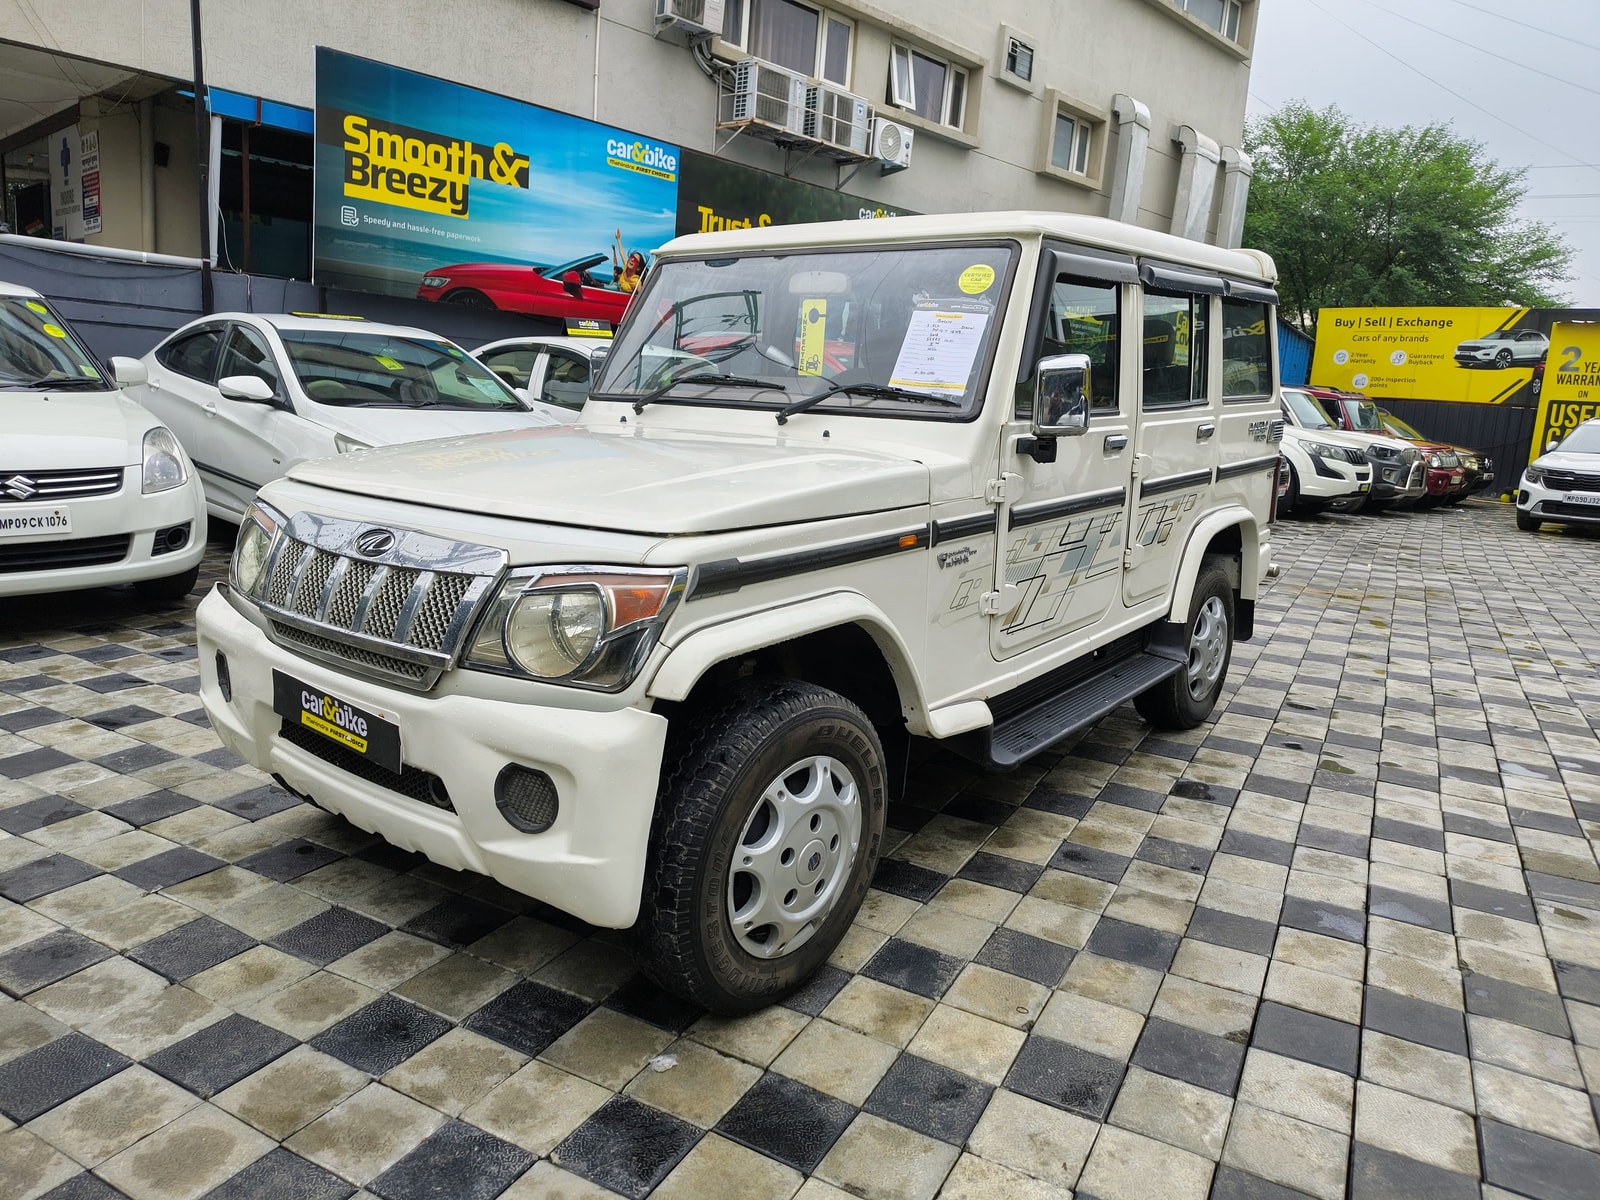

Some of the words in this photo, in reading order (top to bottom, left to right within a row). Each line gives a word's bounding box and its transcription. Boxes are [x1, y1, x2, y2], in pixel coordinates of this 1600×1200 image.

[343, 115, 484, 180] Smooth
[488, 142, 530, 188] &
[606, 138, 676, 171] car&bike
[344, 152, 470, 216] Breezy
[636, 166, 651, 174] FIRST
[651, 170, 671, 179] CHOICE
[363, 215, 391, 228] Speedy
[392, 221, 406, 229] and
[407, 222, 446, 237] hassle-free
[446, 231, 481, 243] paperwork
[1335, 318, 1355, 329] Buy
[1364, 317, 1386, 327] Sell
[1396, 317, 1453, 329] Exchange
[799, 312, 808, 372] INSPECTED
[1352, 334, 1370, 342] Cars
[1371, 334, 1381, 342] of
[1382, 335, 1398, 344] any
[1399, 334, 1429, 343] brands
[1558, 345, 1582, 373] 2
[1577, 390, 1588, 398] ON
[1549, 403, 1600, 427] USE
[0, 516, 68, 530] MP09CK1076
[301, 690, 368, 737] car&bike
[329, 728, 346, 740] FIRST
